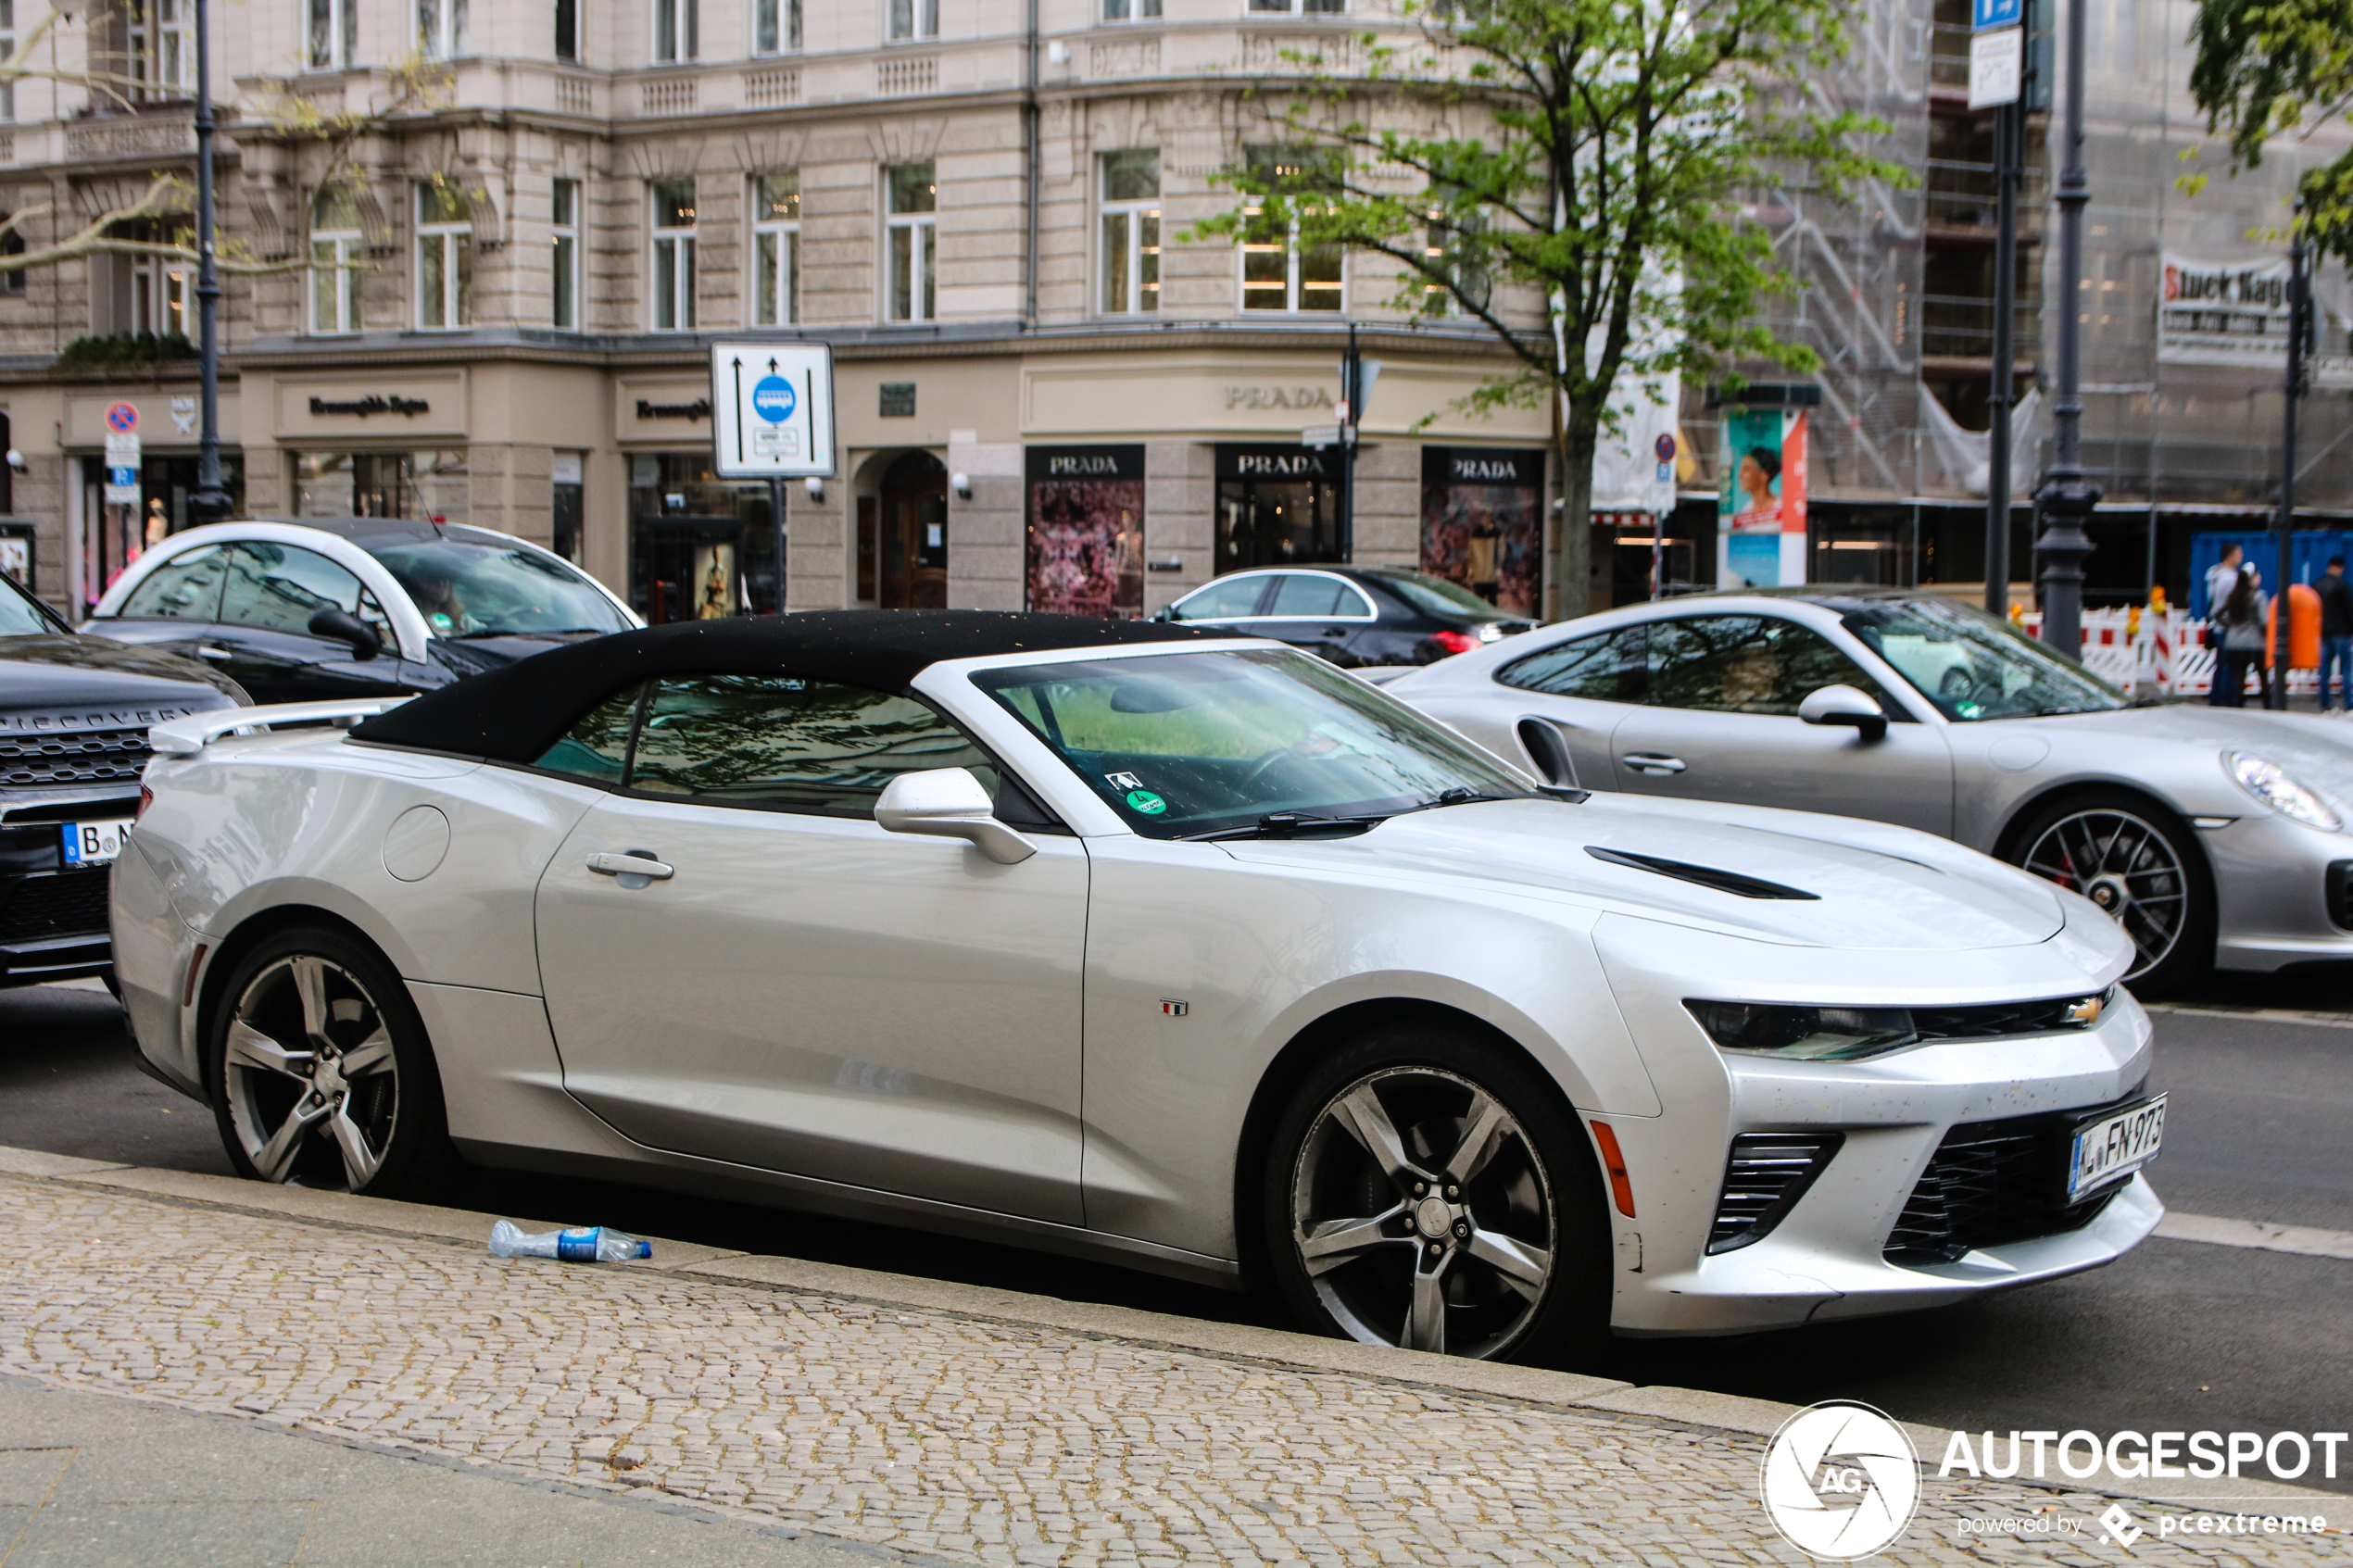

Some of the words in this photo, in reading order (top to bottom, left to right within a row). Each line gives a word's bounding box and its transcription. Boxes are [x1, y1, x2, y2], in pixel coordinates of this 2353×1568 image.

[1226, 385, 1332, 409] PRADA
[1051, 456, 1118, 474] PRADA
[1238, 455, 1324, 473] PRADA
[1453, 459, 1516, 479] PRADA
[84, 827, 100, 854] B
[2133, 1104, 2164, 1154] 973
